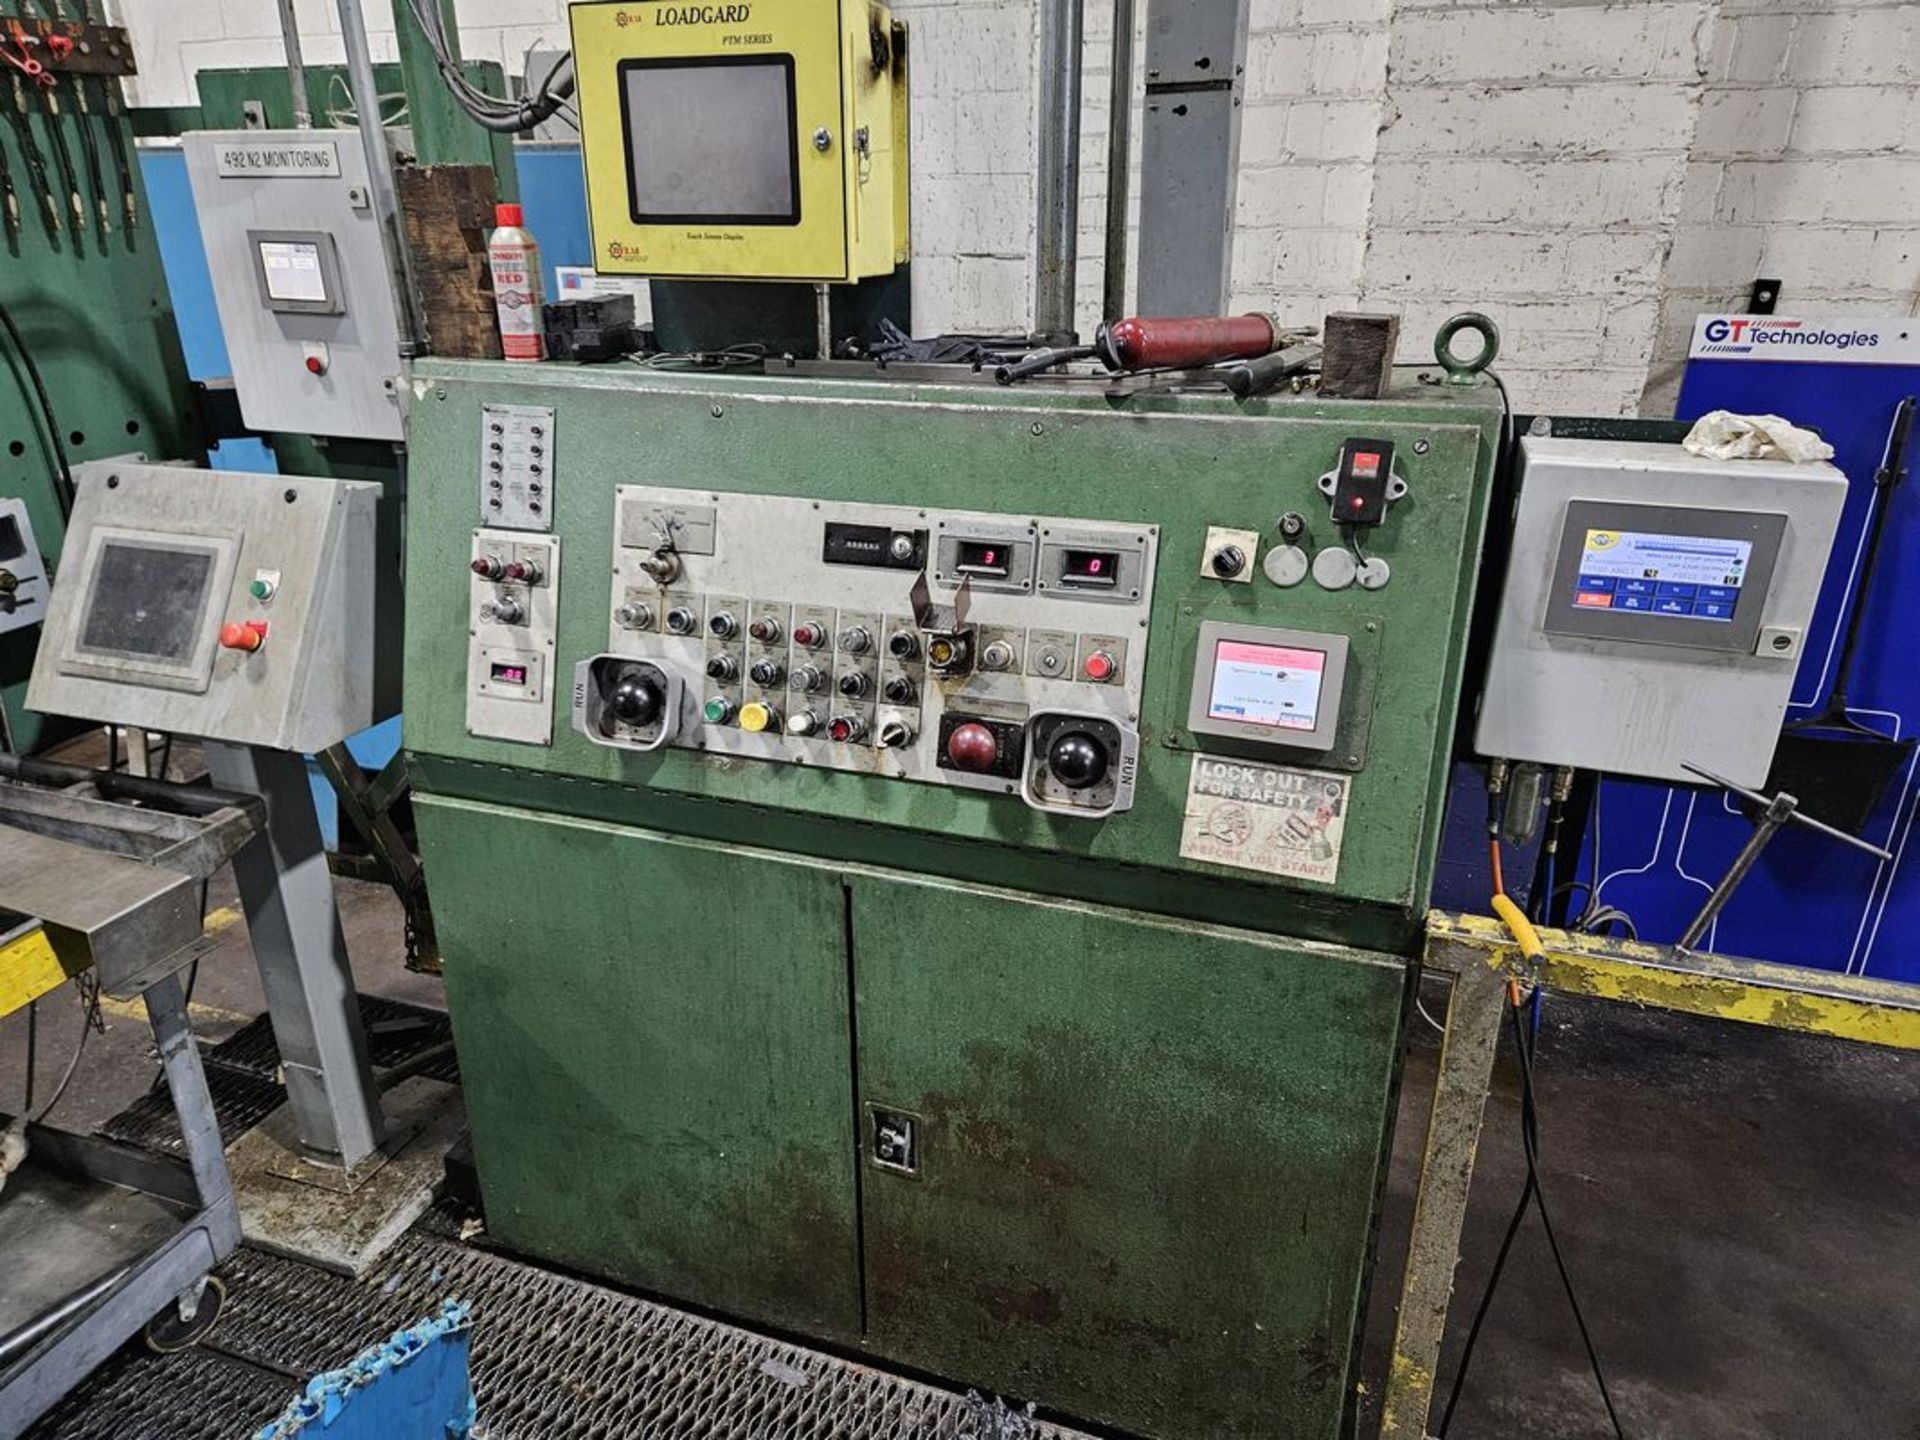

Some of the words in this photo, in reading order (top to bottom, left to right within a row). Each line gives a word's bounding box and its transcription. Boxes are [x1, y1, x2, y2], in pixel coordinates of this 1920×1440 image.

[655, 4, 750, 26] LOADGARD
[722, 35, 742, 45] PTM
[743, 33, 773, 45] SERIES
[224, 151, 246, 168] 492
[246, 151, 262, 168] N2
[262, 150, 330, 168] MONITORING
[1705, 319, 1750, 343] GT
[1750, 328, 1880, 349] Technologies
[984, 551, 995, 564] 3
[575, 683, 584, 708] RUN
[1122, 755, 1135, 785] RUN
[1200, 761, 1256, 784] LOCK
[1262, 770, 1308, 792] OUT
[1196, 779, 1235, 797] FOR
[1238, 783, 1311, 807] SAFETY
[1281, 861, 1328, 876] START
